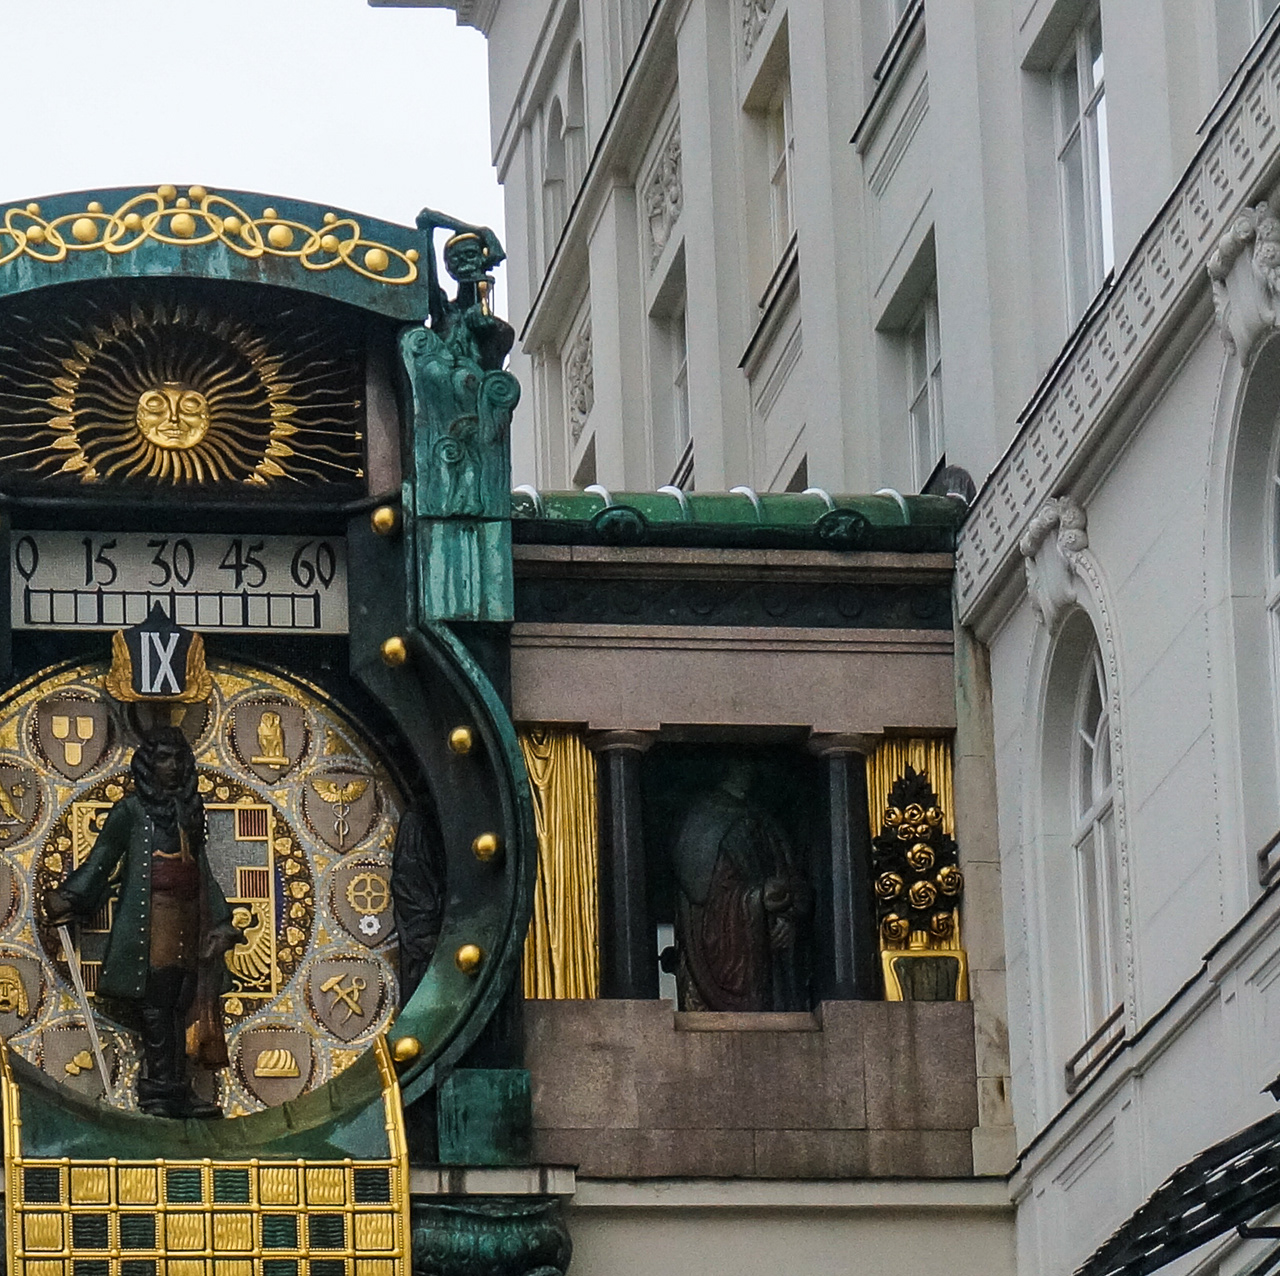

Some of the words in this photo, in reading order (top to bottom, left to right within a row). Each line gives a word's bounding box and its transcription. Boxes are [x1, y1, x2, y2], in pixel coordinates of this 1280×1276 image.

[15, 534, 40, 582] 0
[82, 537, 118, 587] 15
[147, 538, 196, 588] 30
[218, 538, 267, 589] 45
[291, 540, 337, 590] 60
[139, 631, 181, 694] IX
